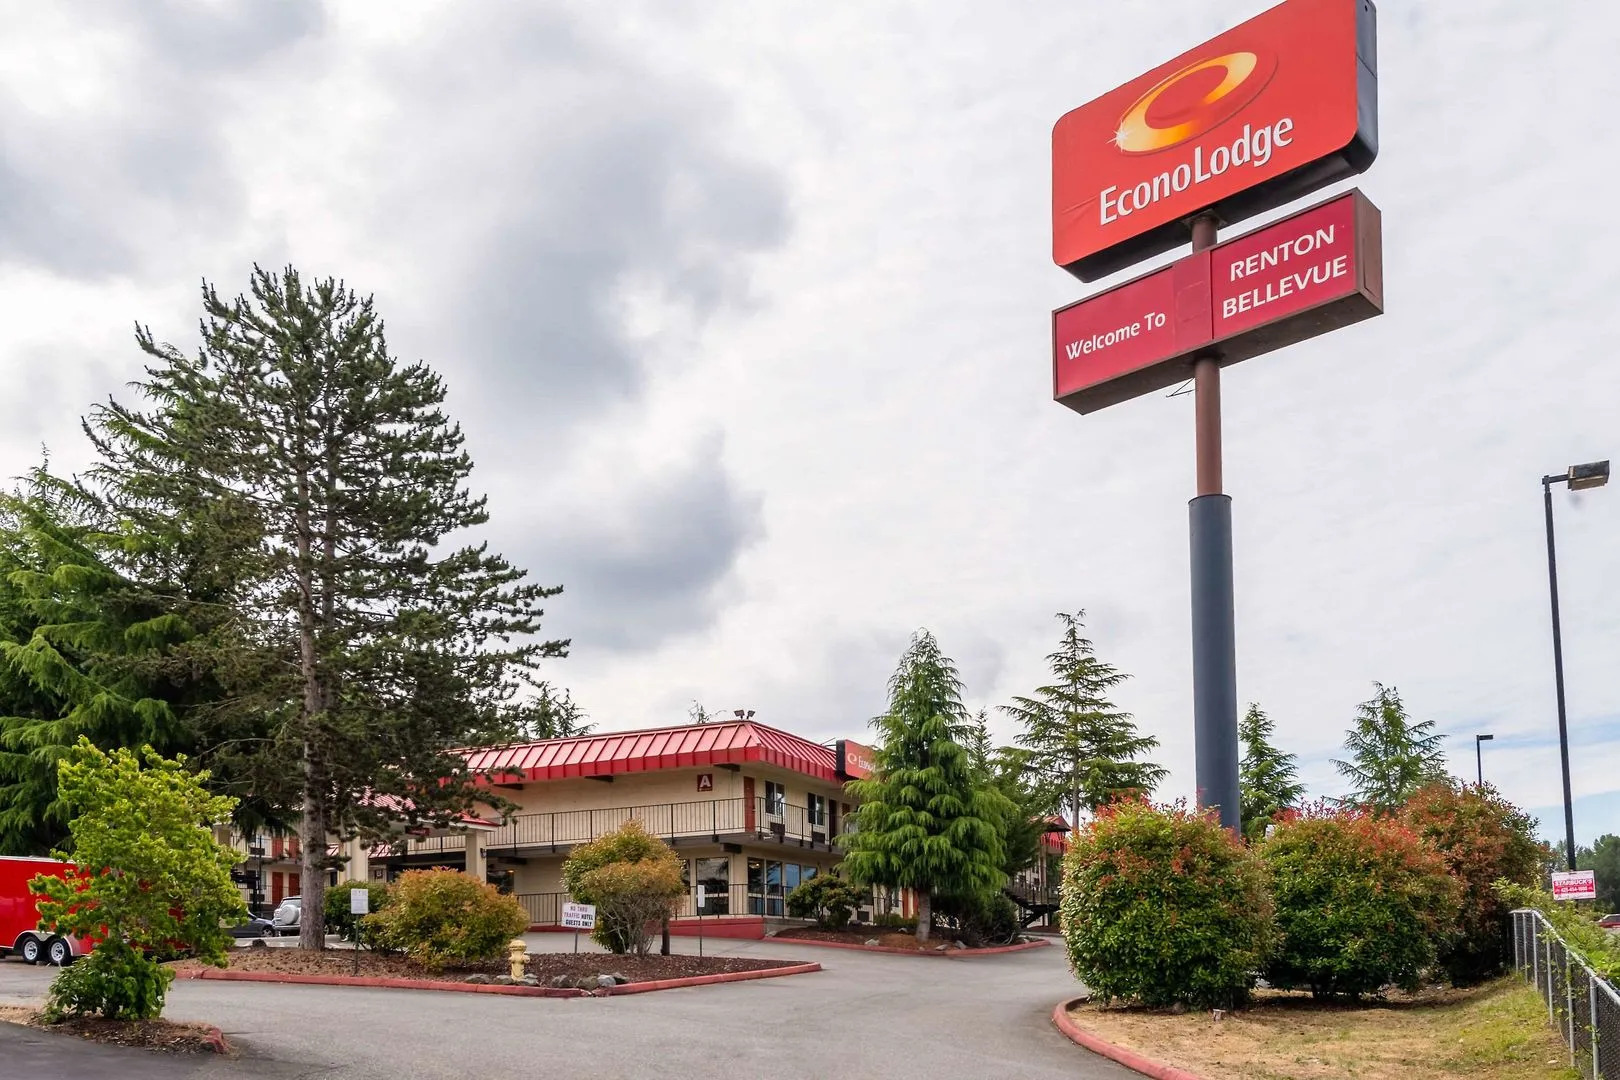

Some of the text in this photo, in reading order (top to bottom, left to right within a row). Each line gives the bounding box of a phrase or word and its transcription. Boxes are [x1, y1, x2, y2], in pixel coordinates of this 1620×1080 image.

[1230, 224, 1335, 282] RENTON
[1222, 255, 1348, 319] BELLEVUE
[1065, 311, 1166, 361] Welcome To
[699, 775, 711, 788] A
